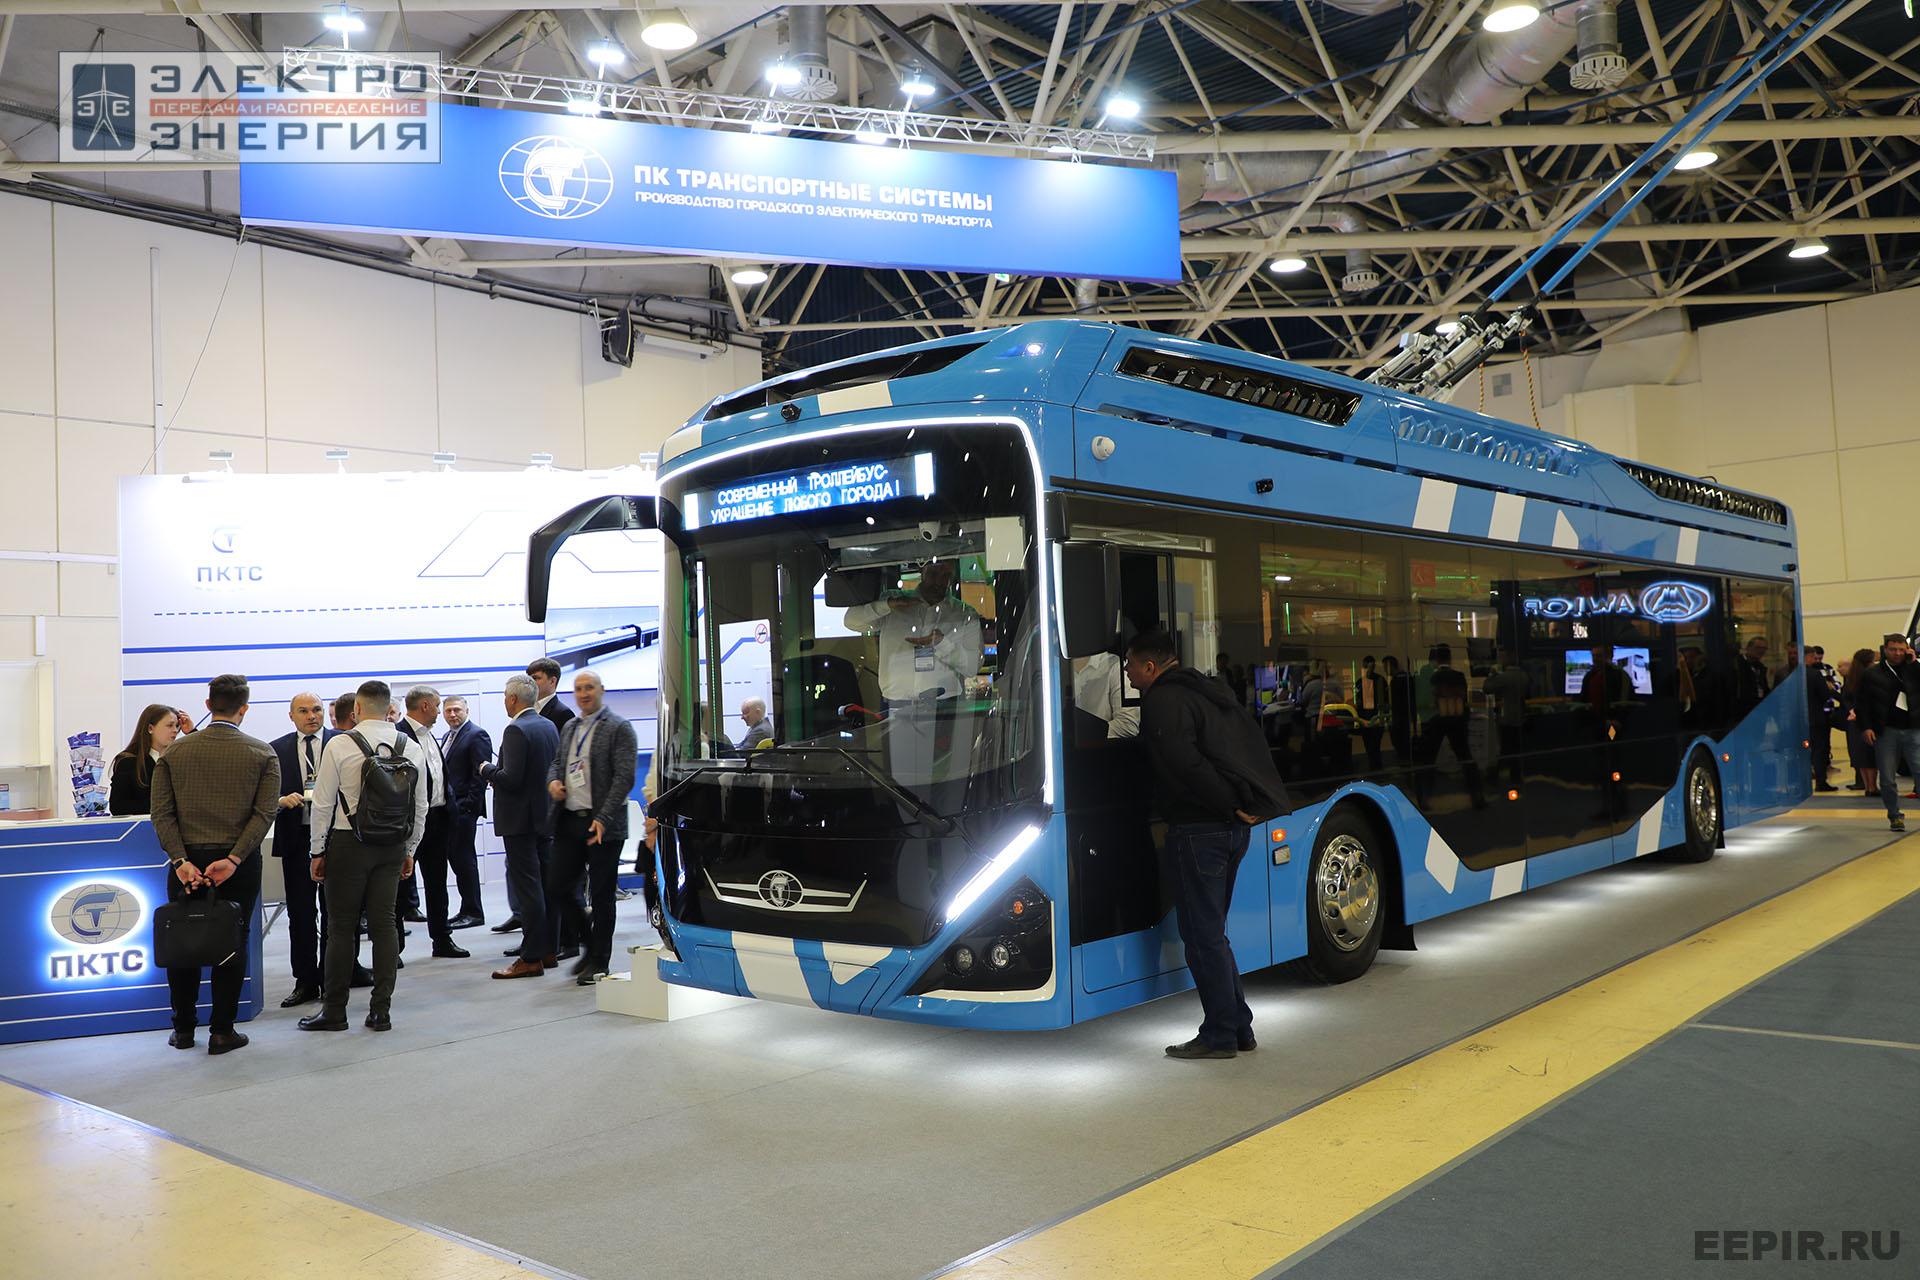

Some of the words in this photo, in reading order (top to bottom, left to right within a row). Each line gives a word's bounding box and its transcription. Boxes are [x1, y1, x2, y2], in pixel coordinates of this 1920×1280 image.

[634, 165, 670, 186] ПК
[676, 168, 872, 202] ТРАНСПОРТНЫЕ
[879, 185, 993, 211] СИСТЕМЫ
[635, 191, 734, 209] ПРОИЗВОДСТВО
[736, 198, 814, 215] ГОРОДСКОГО
[816, 205, 918, 223] ЭЛЕКТРИЧЕСКОГО
[921, 213, 993, 228] ТРАНСПОРТА
[718, 476, 798, 505] СОВРЕМЕННЫЙ
[711, 500, 775, 524] УКРАШЕНИЕ
[783, 491, 831, 513] ЛЮБОГО
[197, 566, 263, 582] ПКТС
[50, 949, 144, 979] ПКТС
